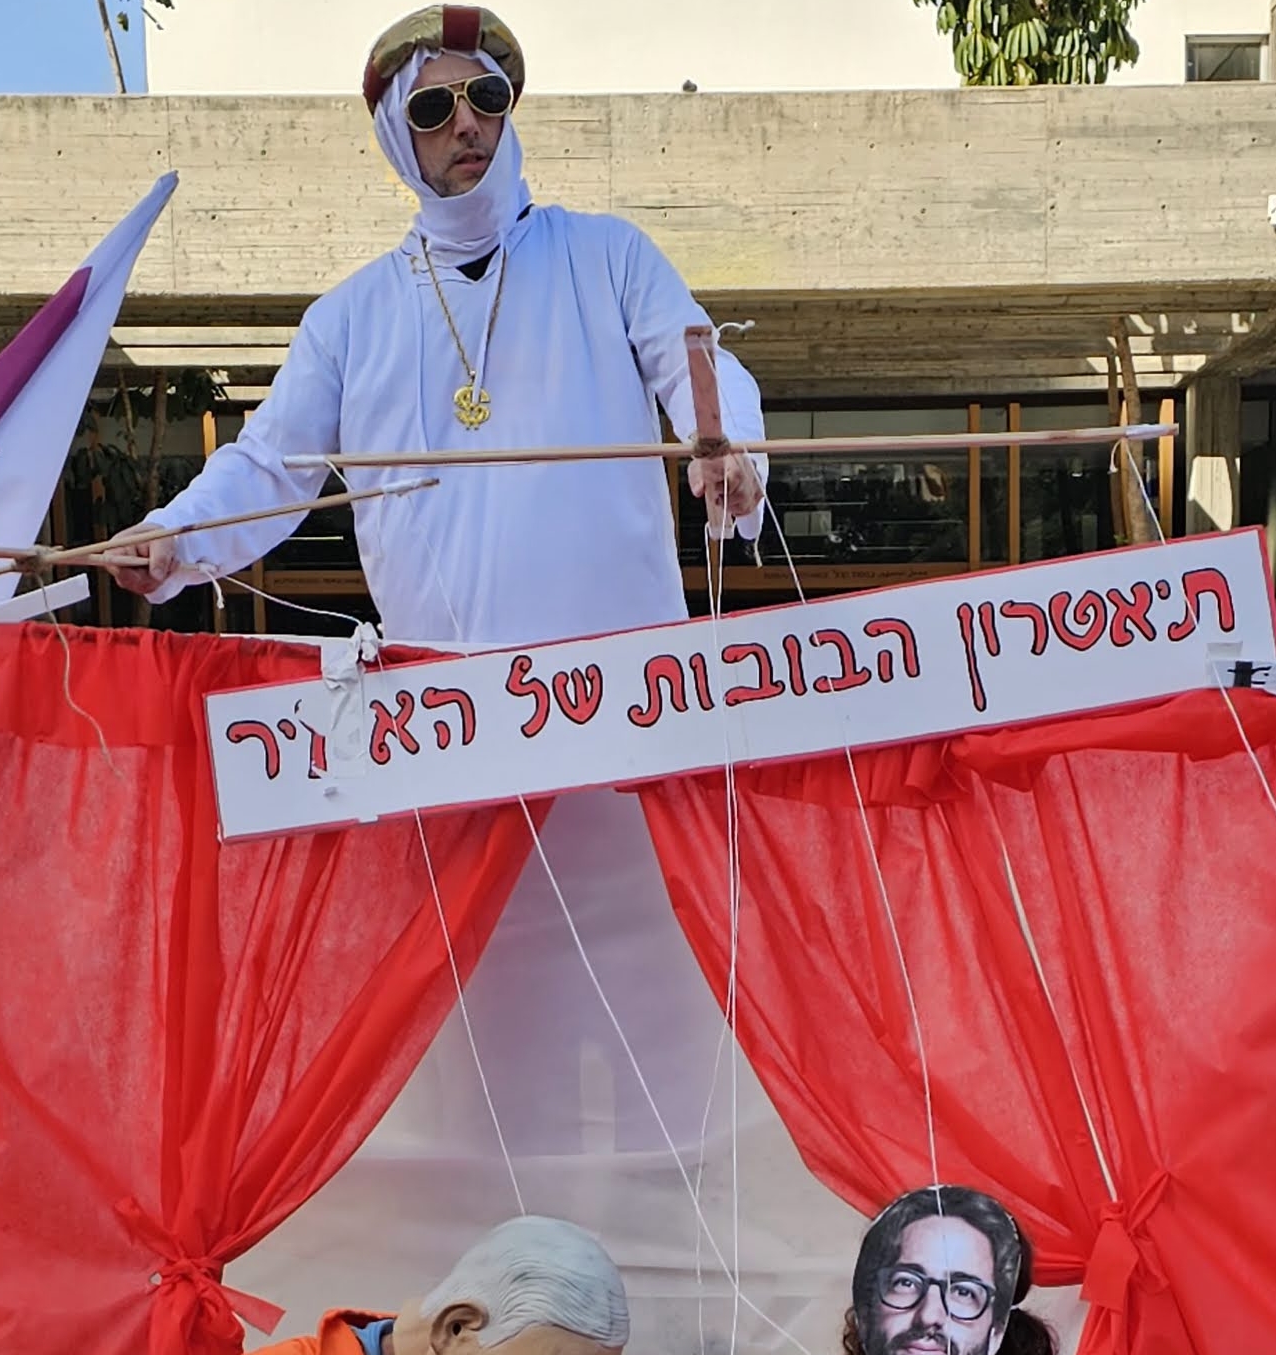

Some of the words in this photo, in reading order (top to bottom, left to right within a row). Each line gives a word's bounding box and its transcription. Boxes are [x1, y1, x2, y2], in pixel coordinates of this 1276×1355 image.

[627, 617, 921, 728] הבובות
[957, 566, 1237, 713] תיאטרון
[504, 654, 604, 739] של
